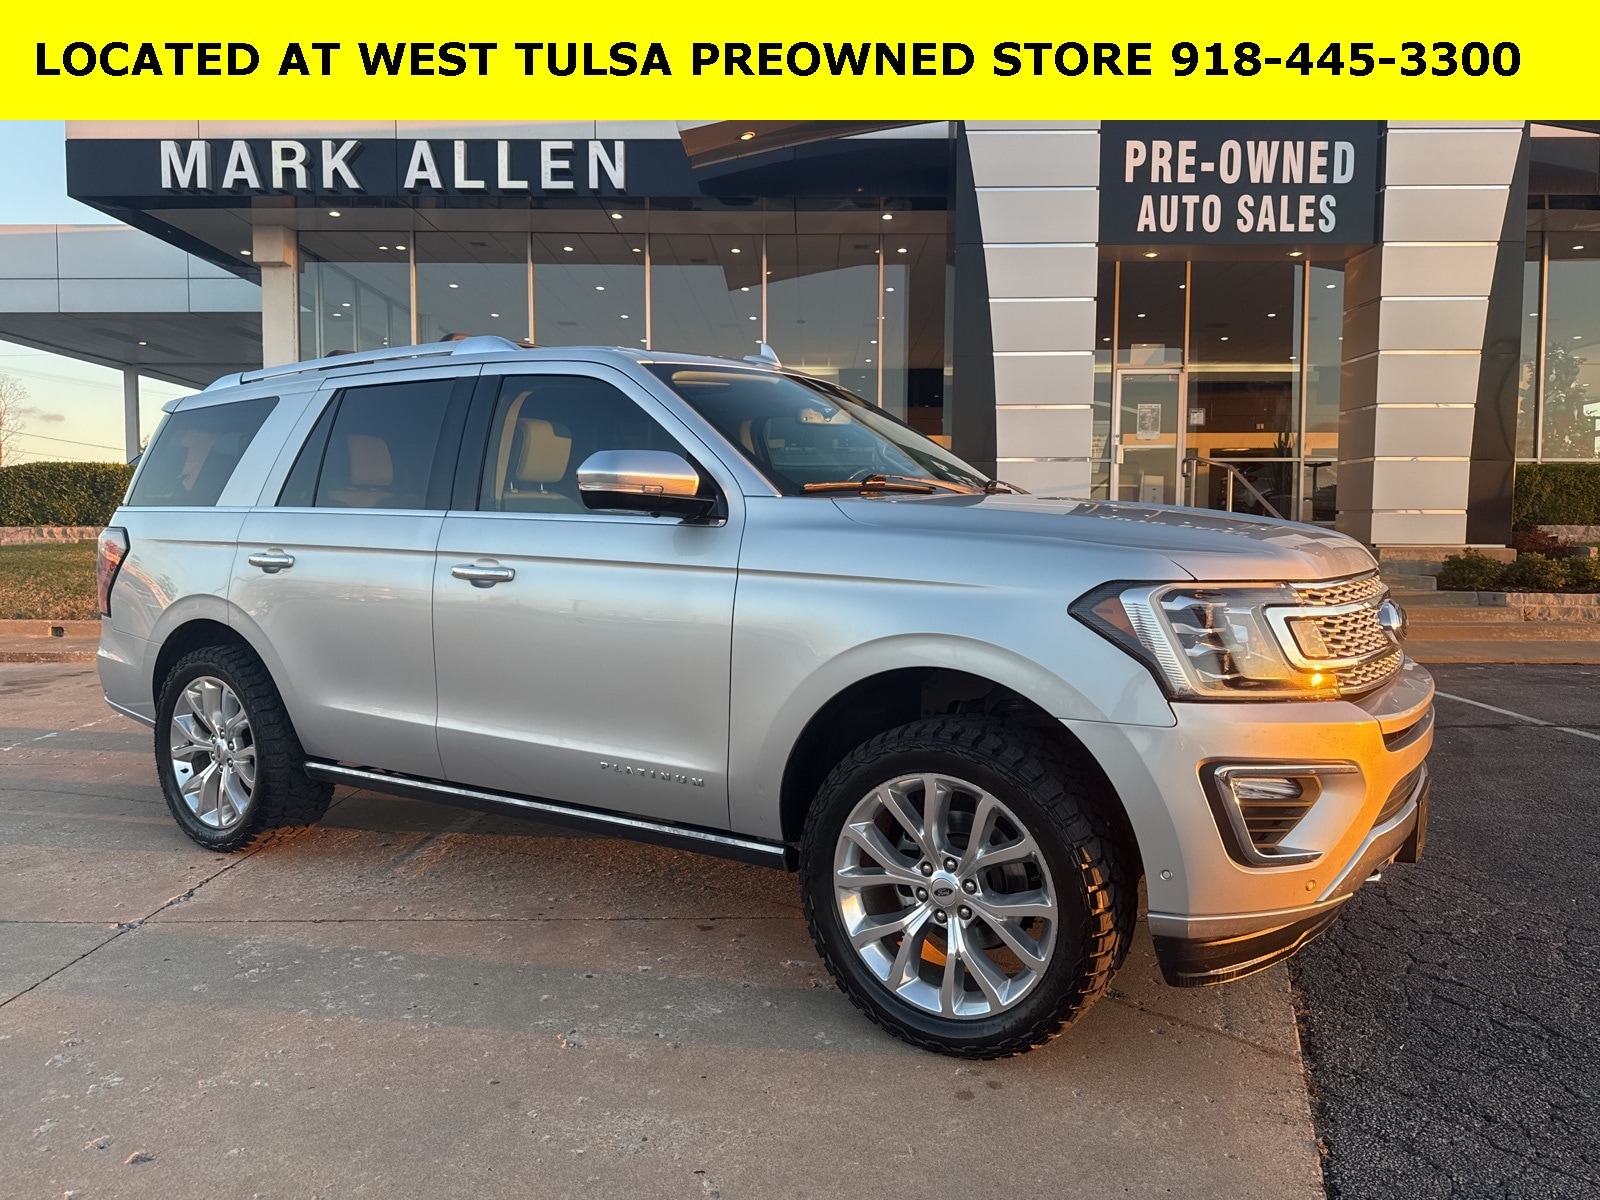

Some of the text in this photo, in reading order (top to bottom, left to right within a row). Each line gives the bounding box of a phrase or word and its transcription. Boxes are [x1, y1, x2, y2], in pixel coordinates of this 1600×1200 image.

[160, 140, 627, 191] MARK ALLEN
[1124, 140, 1355, 184] PRE-OWNED
[1137, 194, 1337, 233] AUTO SALES
[600, 761, 704, 787] PLATINUM
